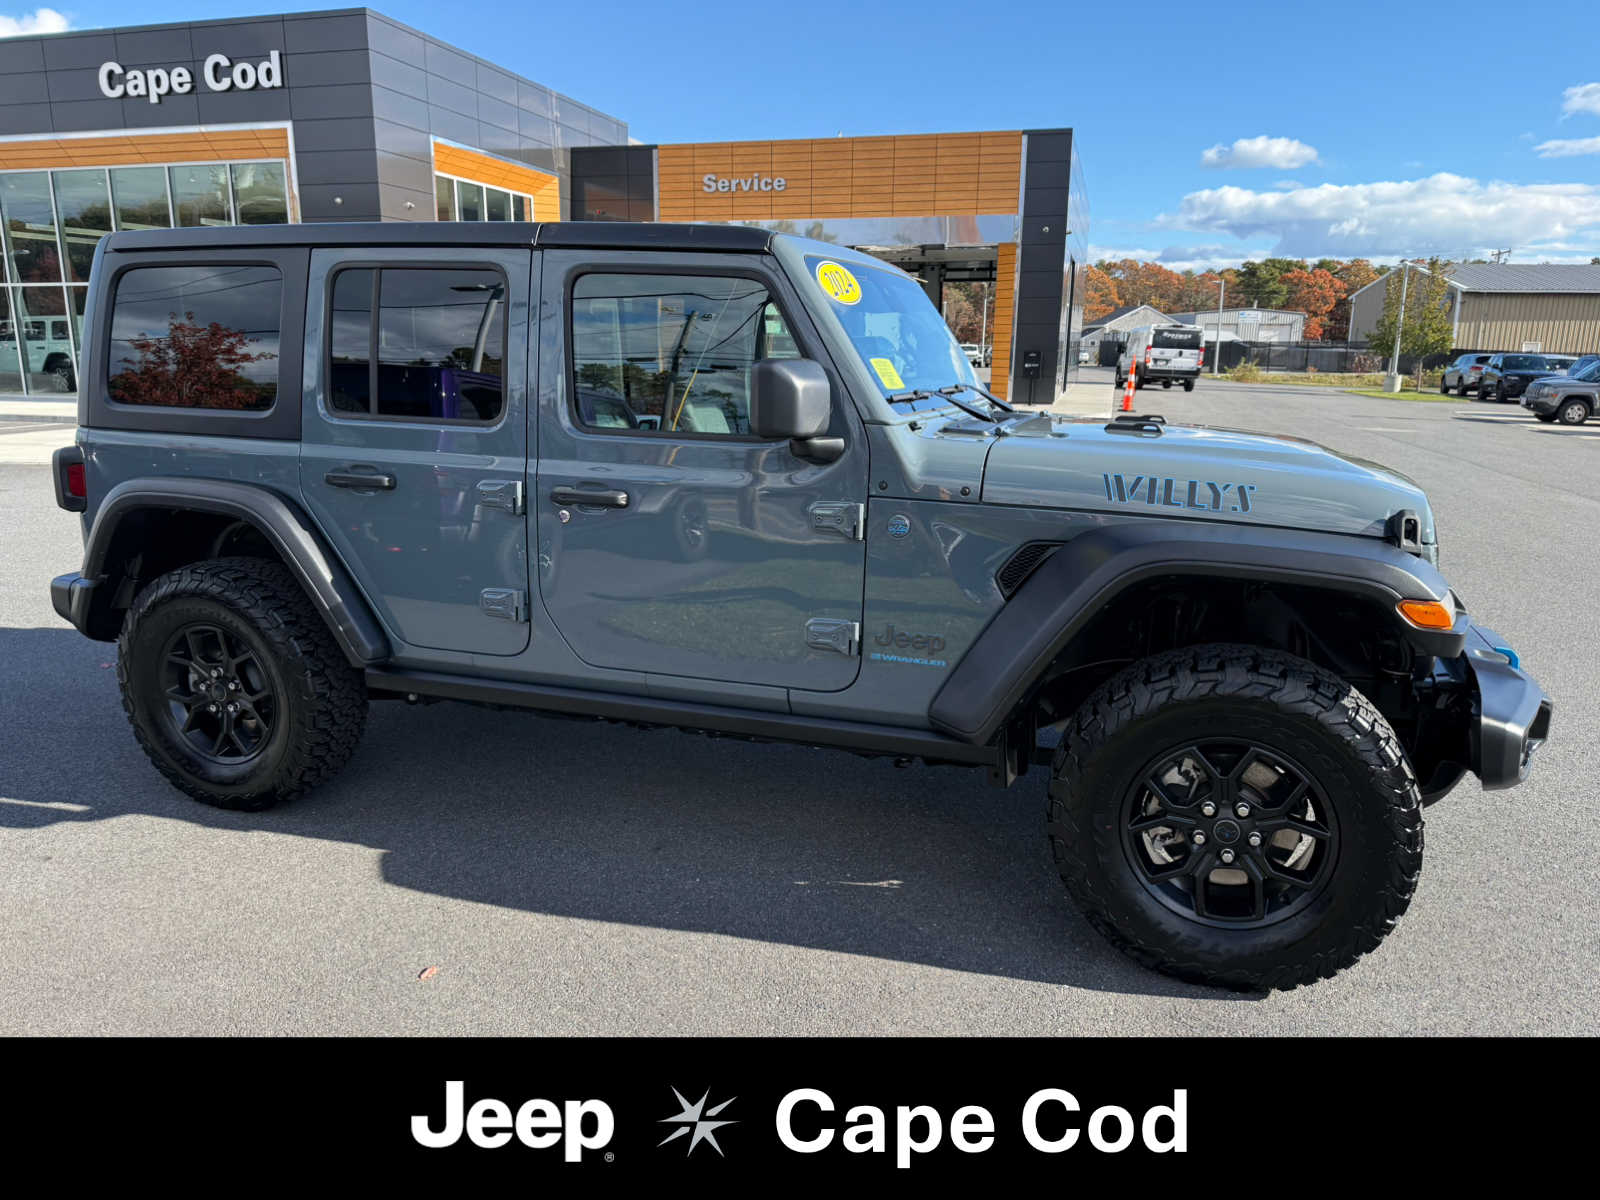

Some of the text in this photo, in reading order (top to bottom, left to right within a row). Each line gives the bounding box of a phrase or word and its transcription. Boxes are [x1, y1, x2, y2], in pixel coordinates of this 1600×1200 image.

[99, 50, 282, 103] Cape Cod
[703, 172, 786, 193] Service
[823, 270, 856, 297] 2024
[1103, 472, 1257, 513] WILLYS
[873, 623, 946, 656] Jeep
